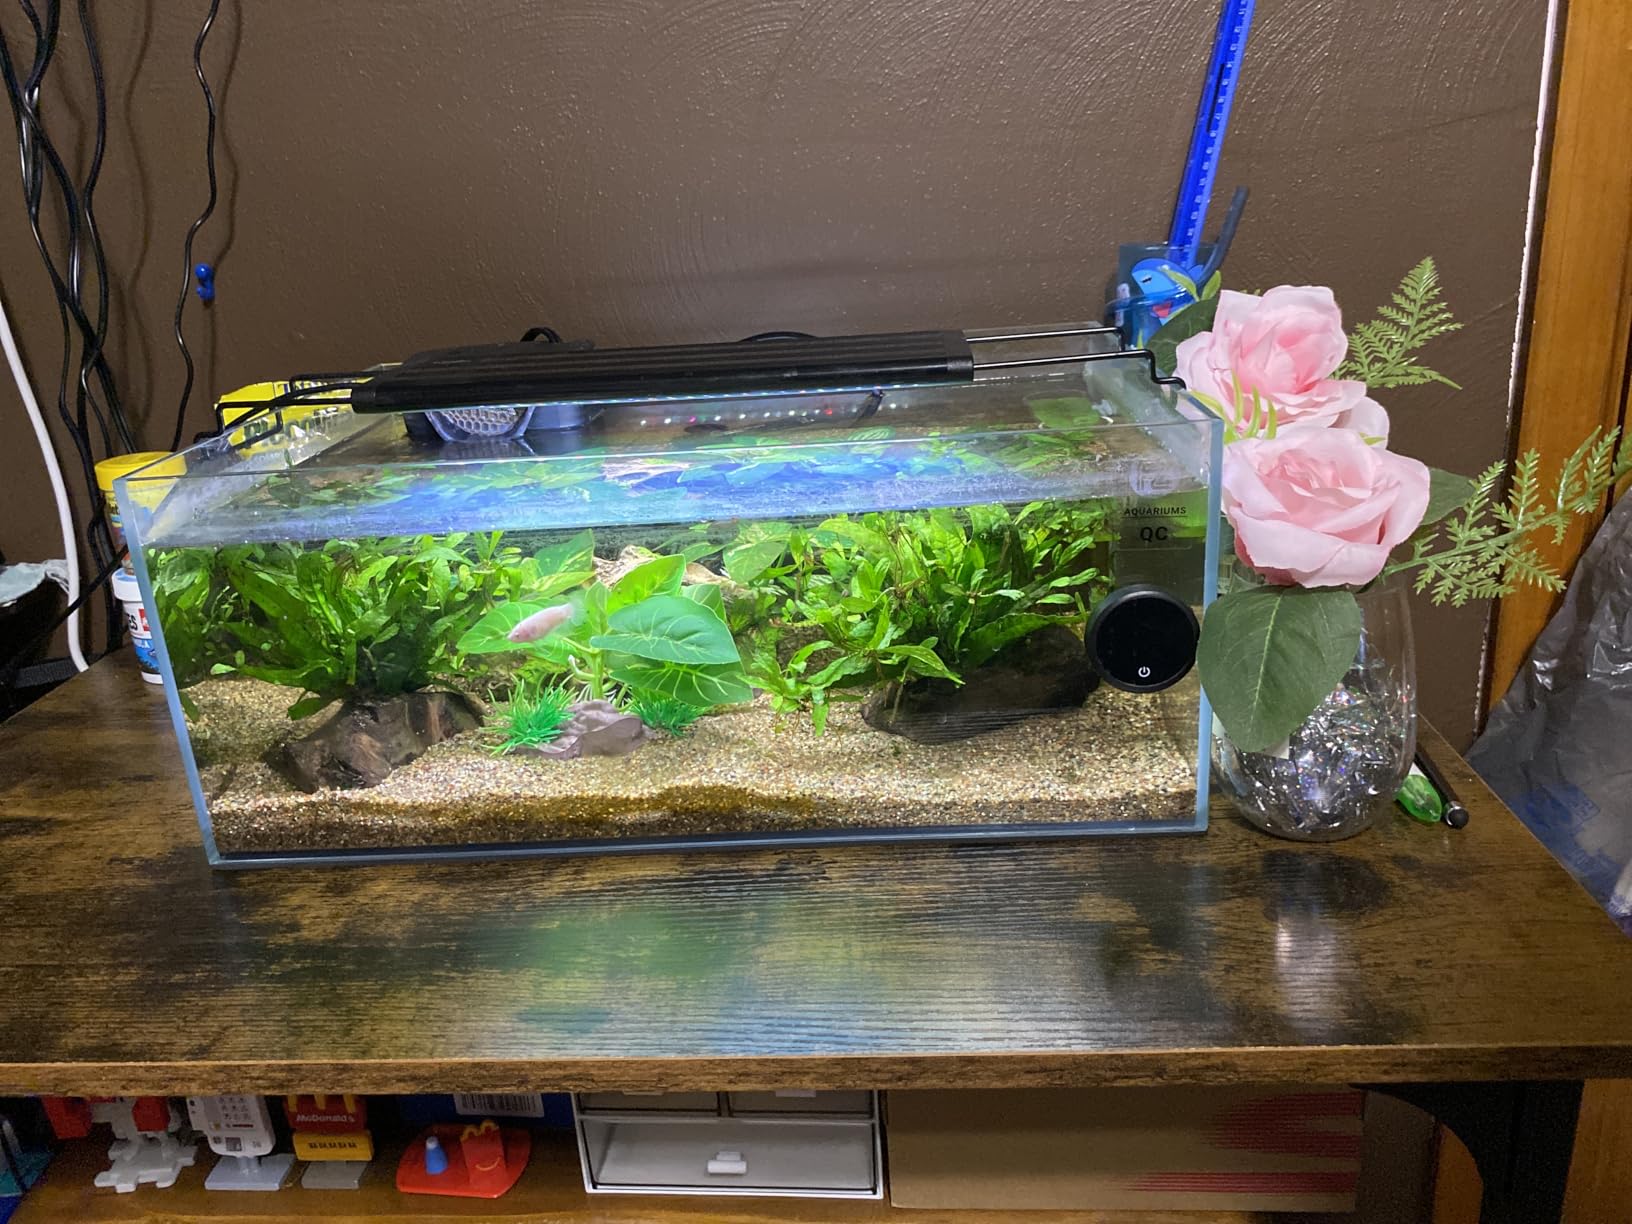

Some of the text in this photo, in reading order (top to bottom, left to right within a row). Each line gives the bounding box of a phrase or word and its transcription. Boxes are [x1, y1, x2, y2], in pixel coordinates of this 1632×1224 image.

[1123, 506, 1186, 516] AQUARIUMS
[1140, 526, 1169, 543] QC
[296, 1113, 356, 1123] McDonald's
